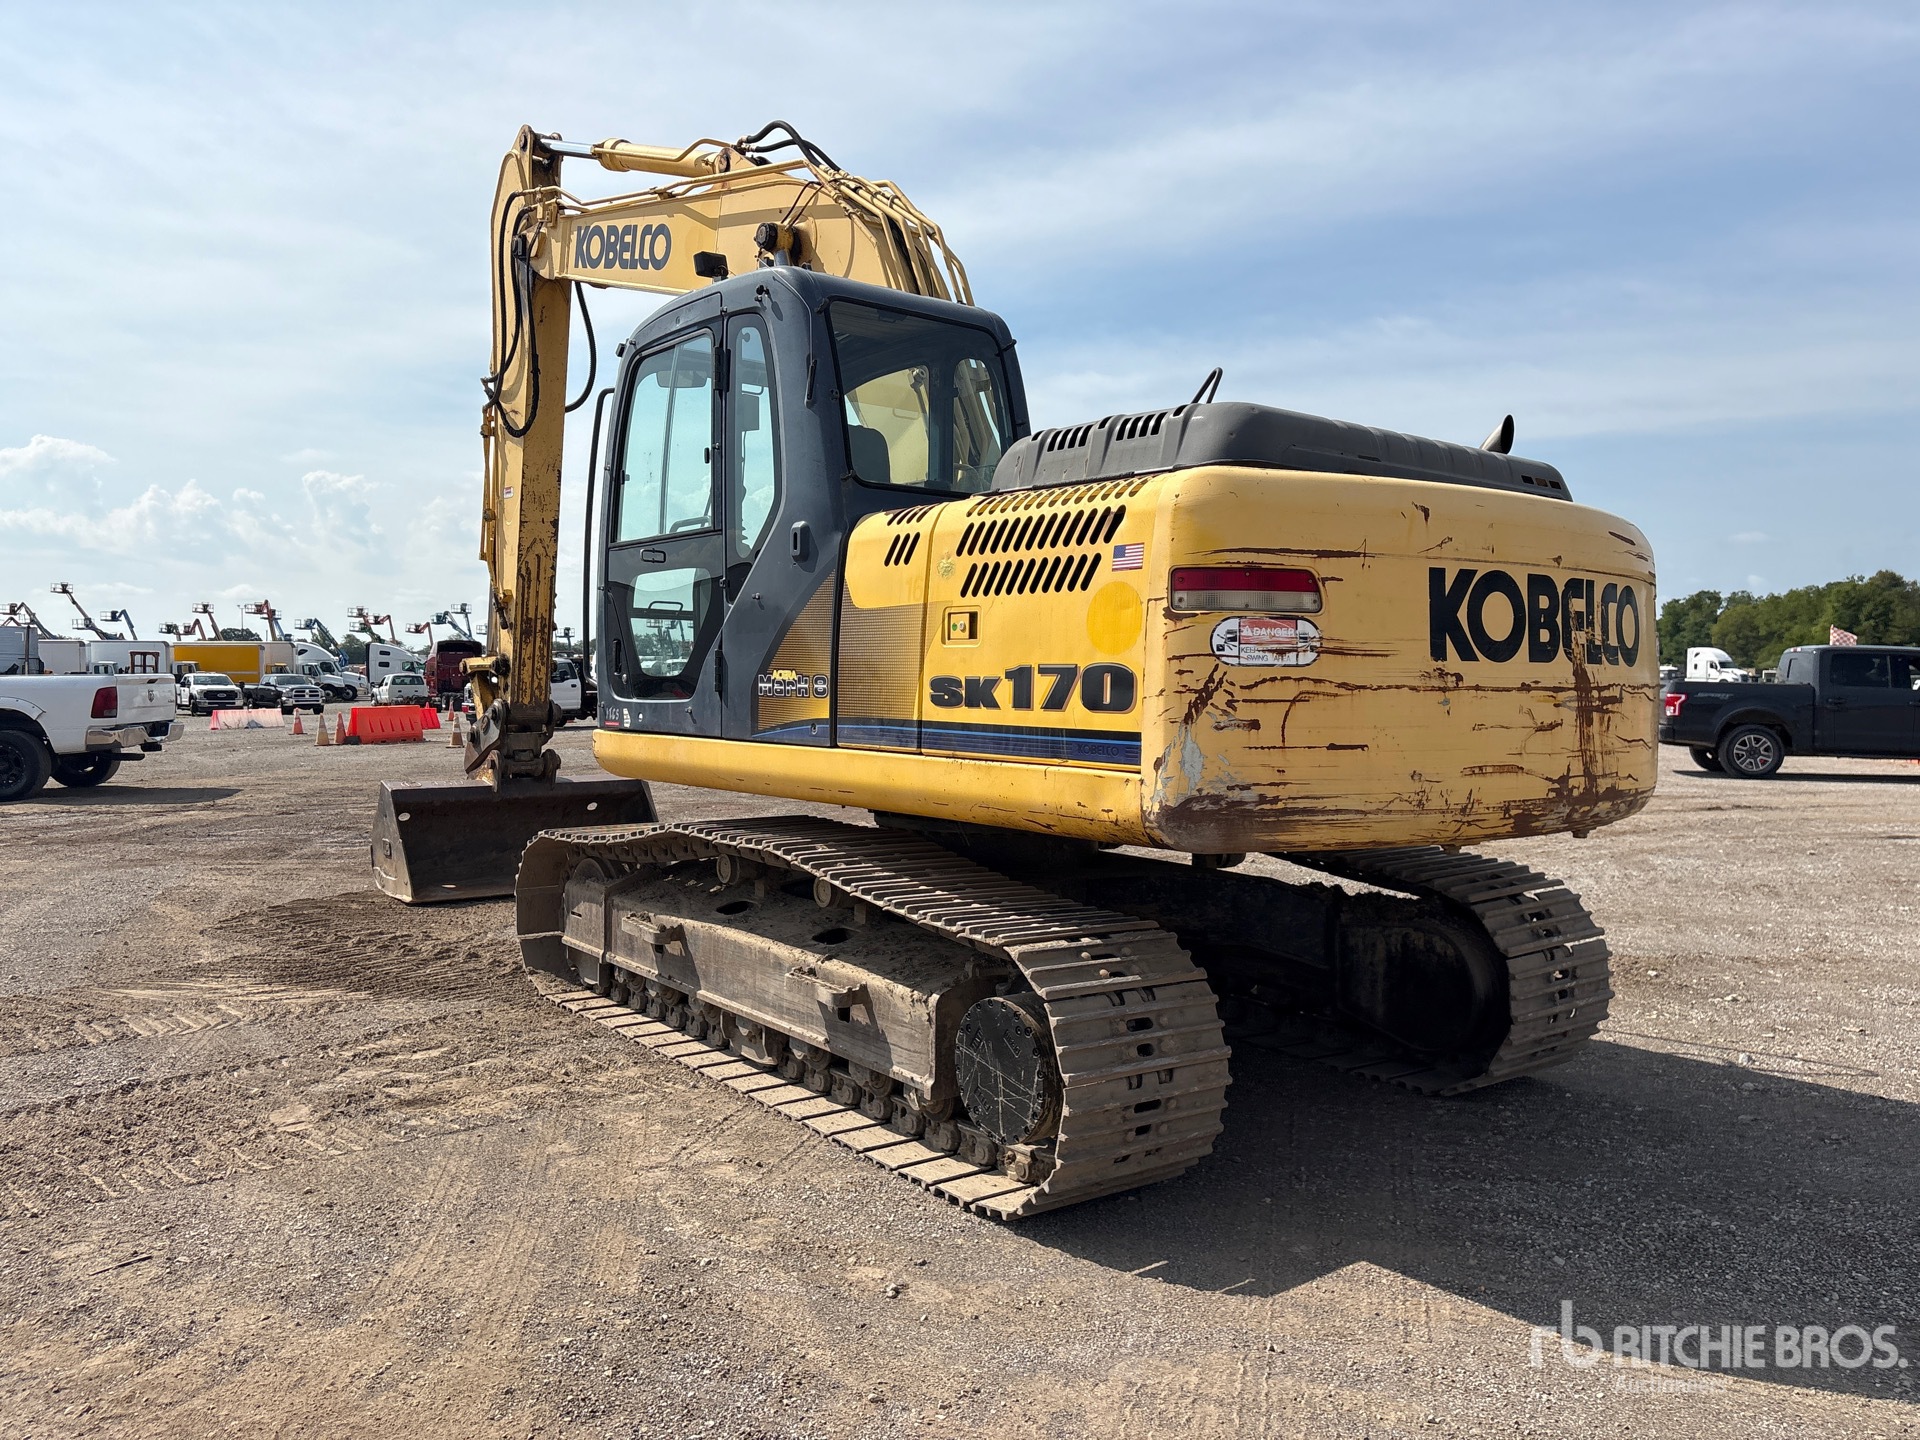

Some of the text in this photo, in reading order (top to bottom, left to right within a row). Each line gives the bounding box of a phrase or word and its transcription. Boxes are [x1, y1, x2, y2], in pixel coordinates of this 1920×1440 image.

[574, 223, 672, 271] KOBELCO
[1253, 627, 1295, 637] DANGER
[1429, 567, 1640, 667] KOBELCO
[813, 675, 828, 698] 8
[929, 662, 1138, 714] SK170
[1077, 743, 1120, 757] KOBELCO
